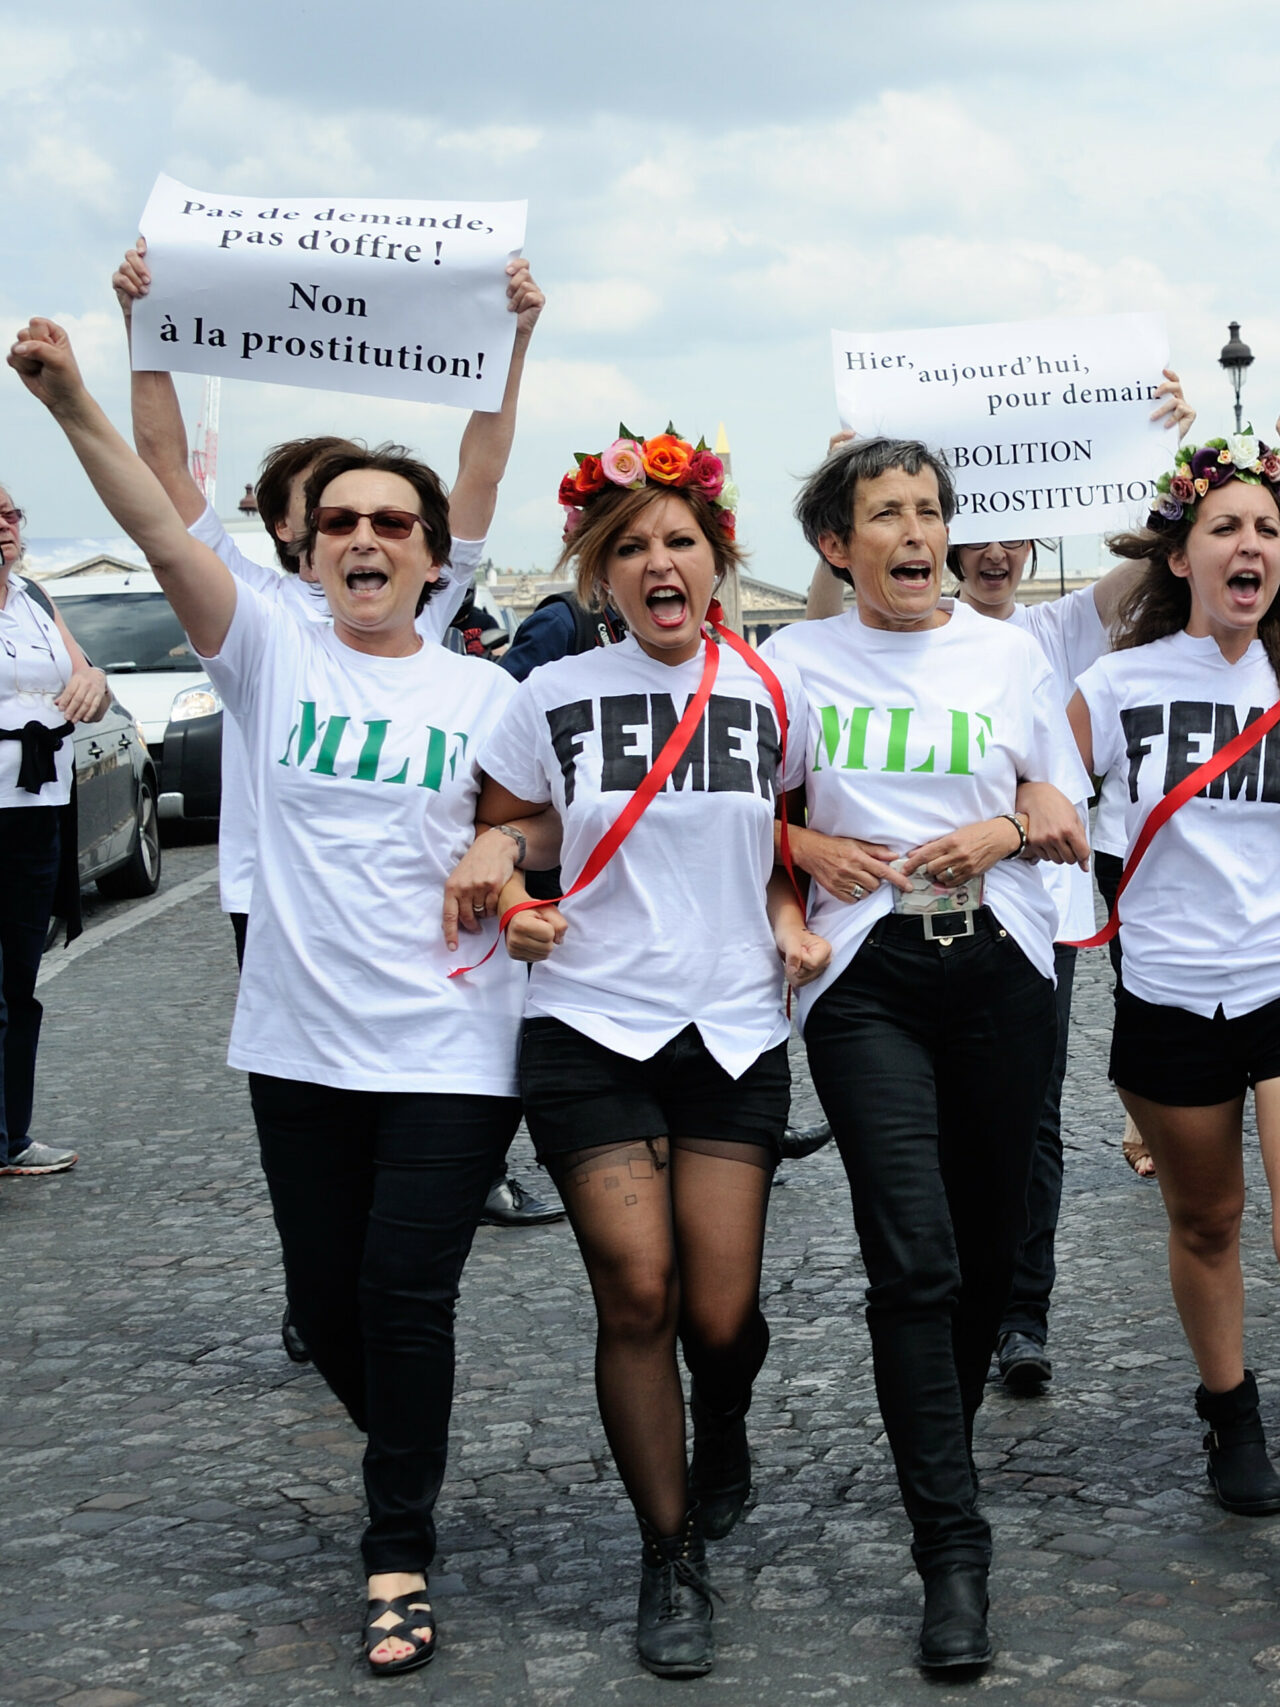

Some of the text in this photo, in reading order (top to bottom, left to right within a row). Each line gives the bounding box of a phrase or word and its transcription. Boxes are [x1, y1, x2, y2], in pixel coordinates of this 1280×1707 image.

[182, 200, 495, 235] Pas de demande,
[218, 228, 283, 249] pas
[288, 281, 368, 318] Non
[159, 314, 485, 380] à la prostitution!
[844, 351, 1090, 387] Hier, aujourd'hui,
[987, 391, 1052, 416] pour
[278, 700, 470, 793] MLF
[812, 704, 993, 776] MLF
